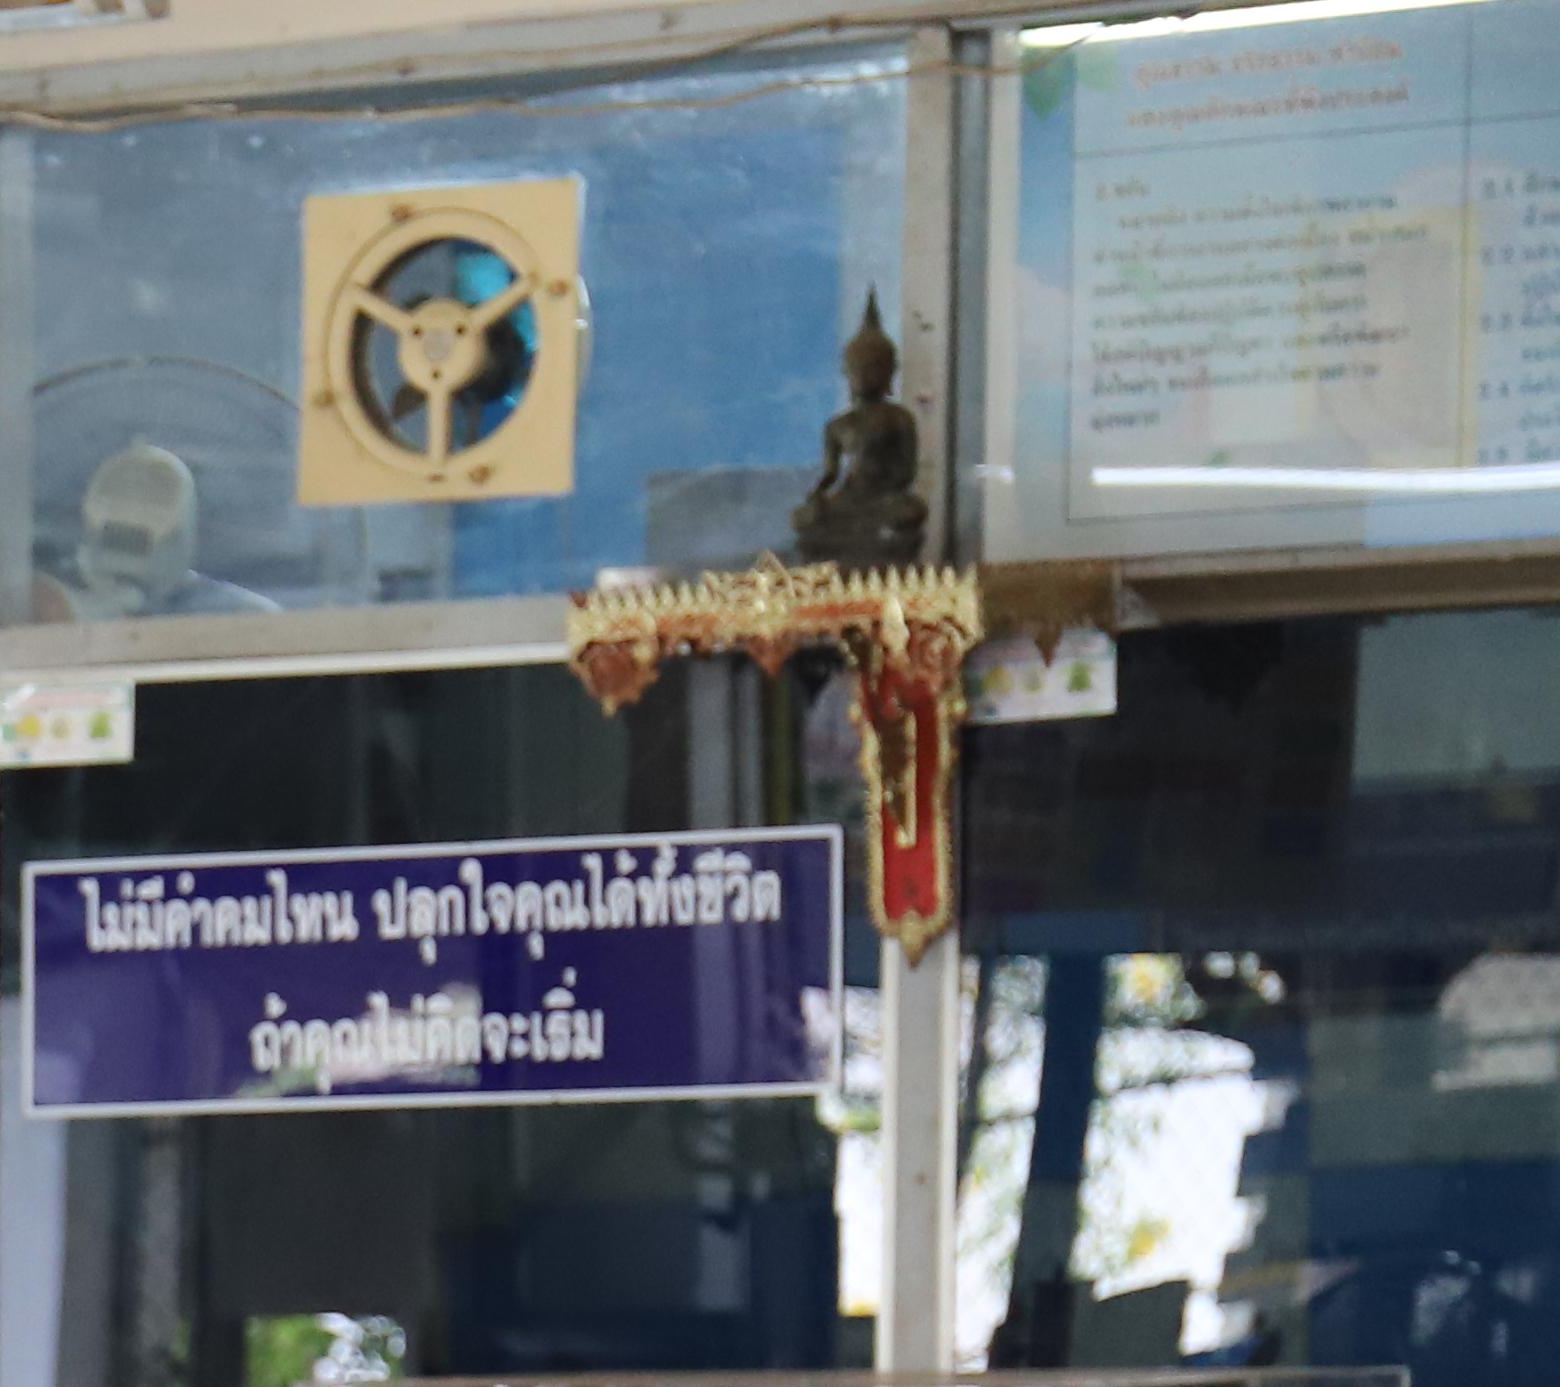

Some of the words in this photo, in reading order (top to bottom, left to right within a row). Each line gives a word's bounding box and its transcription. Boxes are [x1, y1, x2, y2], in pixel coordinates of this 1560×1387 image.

[372, 841, 781, 966] ปลุกใจคุณได้ทั้งชีวิต
[249, 966, 605, 1095] ถ้าคุณไม่คิดจะเริ่ม
